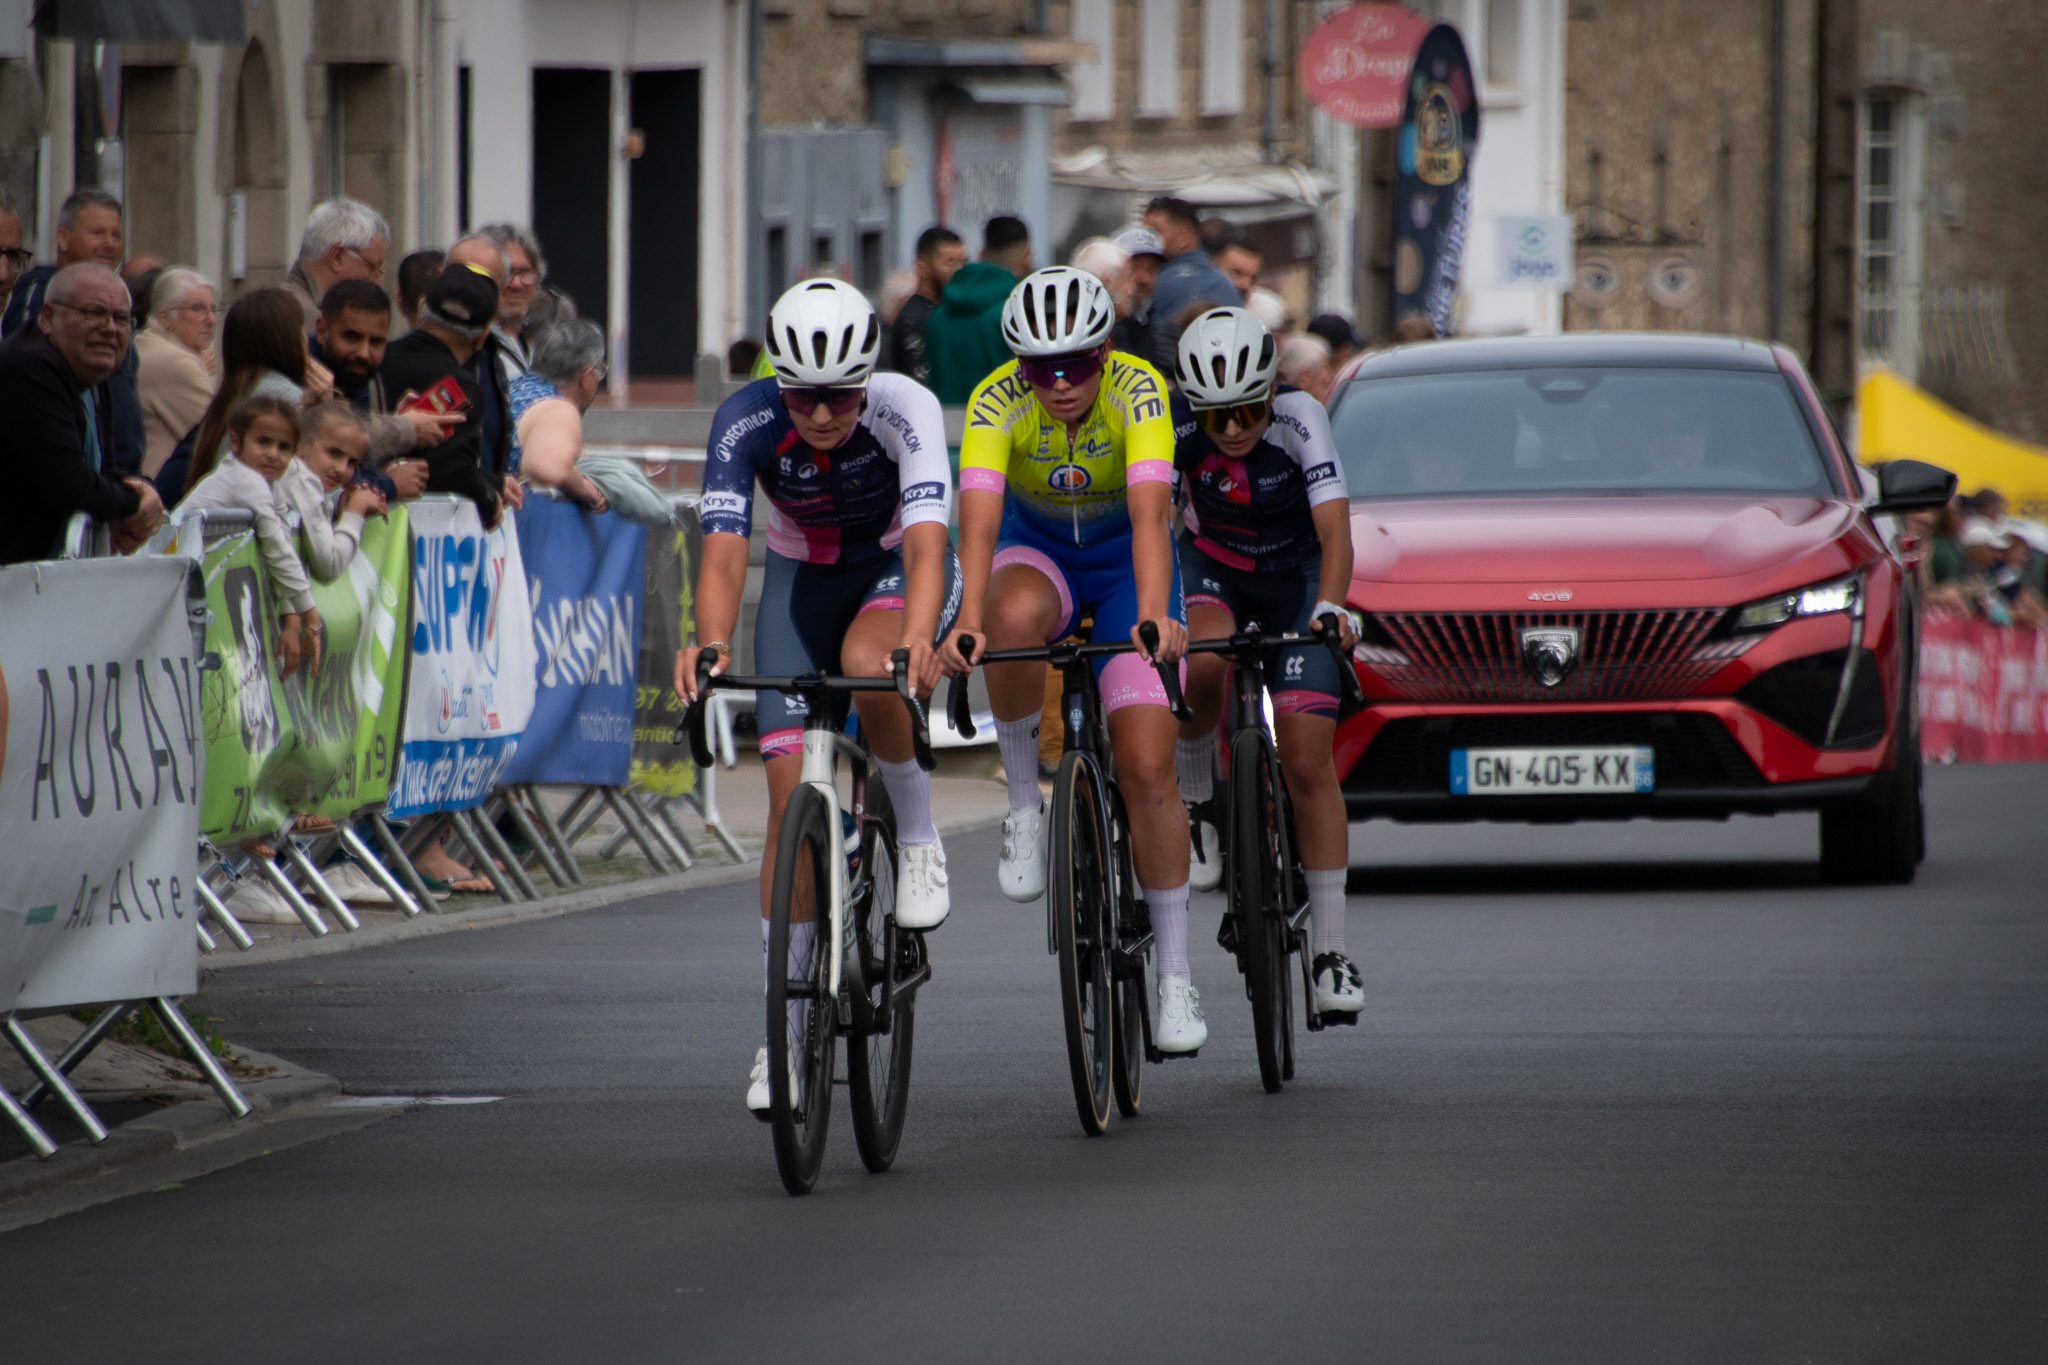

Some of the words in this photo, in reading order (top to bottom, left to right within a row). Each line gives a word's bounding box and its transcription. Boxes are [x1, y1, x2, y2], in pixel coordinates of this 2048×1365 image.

[721, 407, 775, 448] DECATHLON
[1306, 465, 1332, 482] Krys
[703, 495, 737, 508] Krys
[904, 486, 938, 502] Krys
[1528, 590, 1573, 602] 408
[108, 860, 184, 926] Alre
